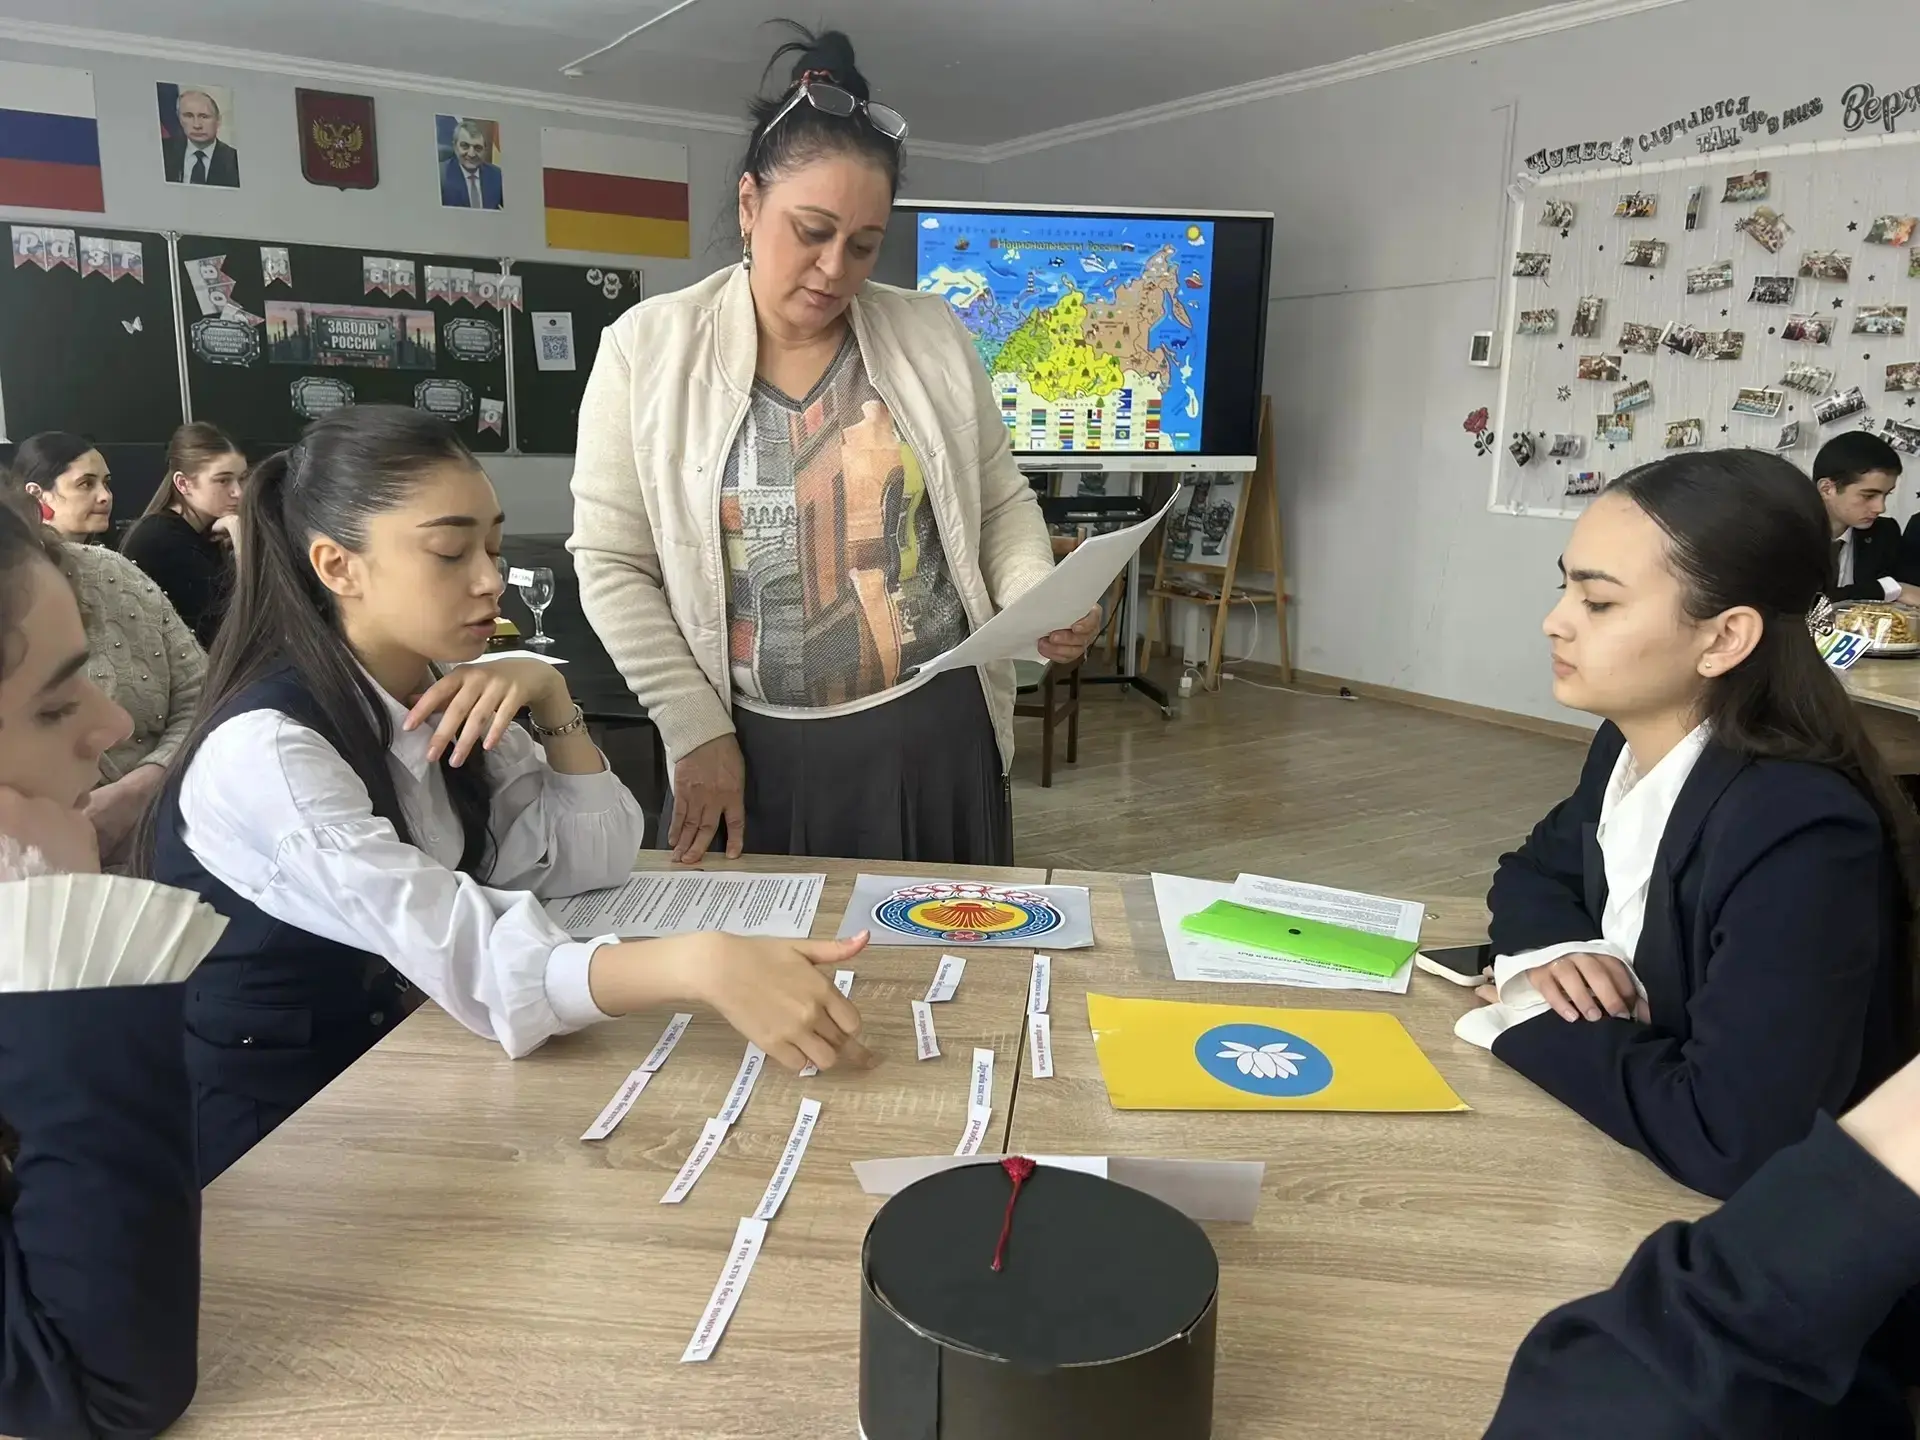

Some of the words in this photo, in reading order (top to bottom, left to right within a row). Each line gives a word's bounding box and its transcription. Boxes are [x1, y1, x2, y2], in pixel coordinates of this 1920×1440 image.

[998, 237, 1084, 252] Национальности
[1087, 240, 1123, 253] России
[328, 320, 378, 336] ЗАВОДЫ
[331, 335, 377, 350] РОССИИ
[977, 1061, 988, 1083] Дружба
[729, 1096, 740, 1108] твой
[796, 1126, 806, 1136] тот
[788, 1137, 801, 1153] друг,
[690, 1147, 708, 1167] скажу,
[784, 1154, 794, 1165] кто
[682, 1169, 694, 1180] кто
[770, 1176, 784, 1191] пиру
[729, 1265, 741, 1278] кто
[716, 1287, 733, 1305] беде
